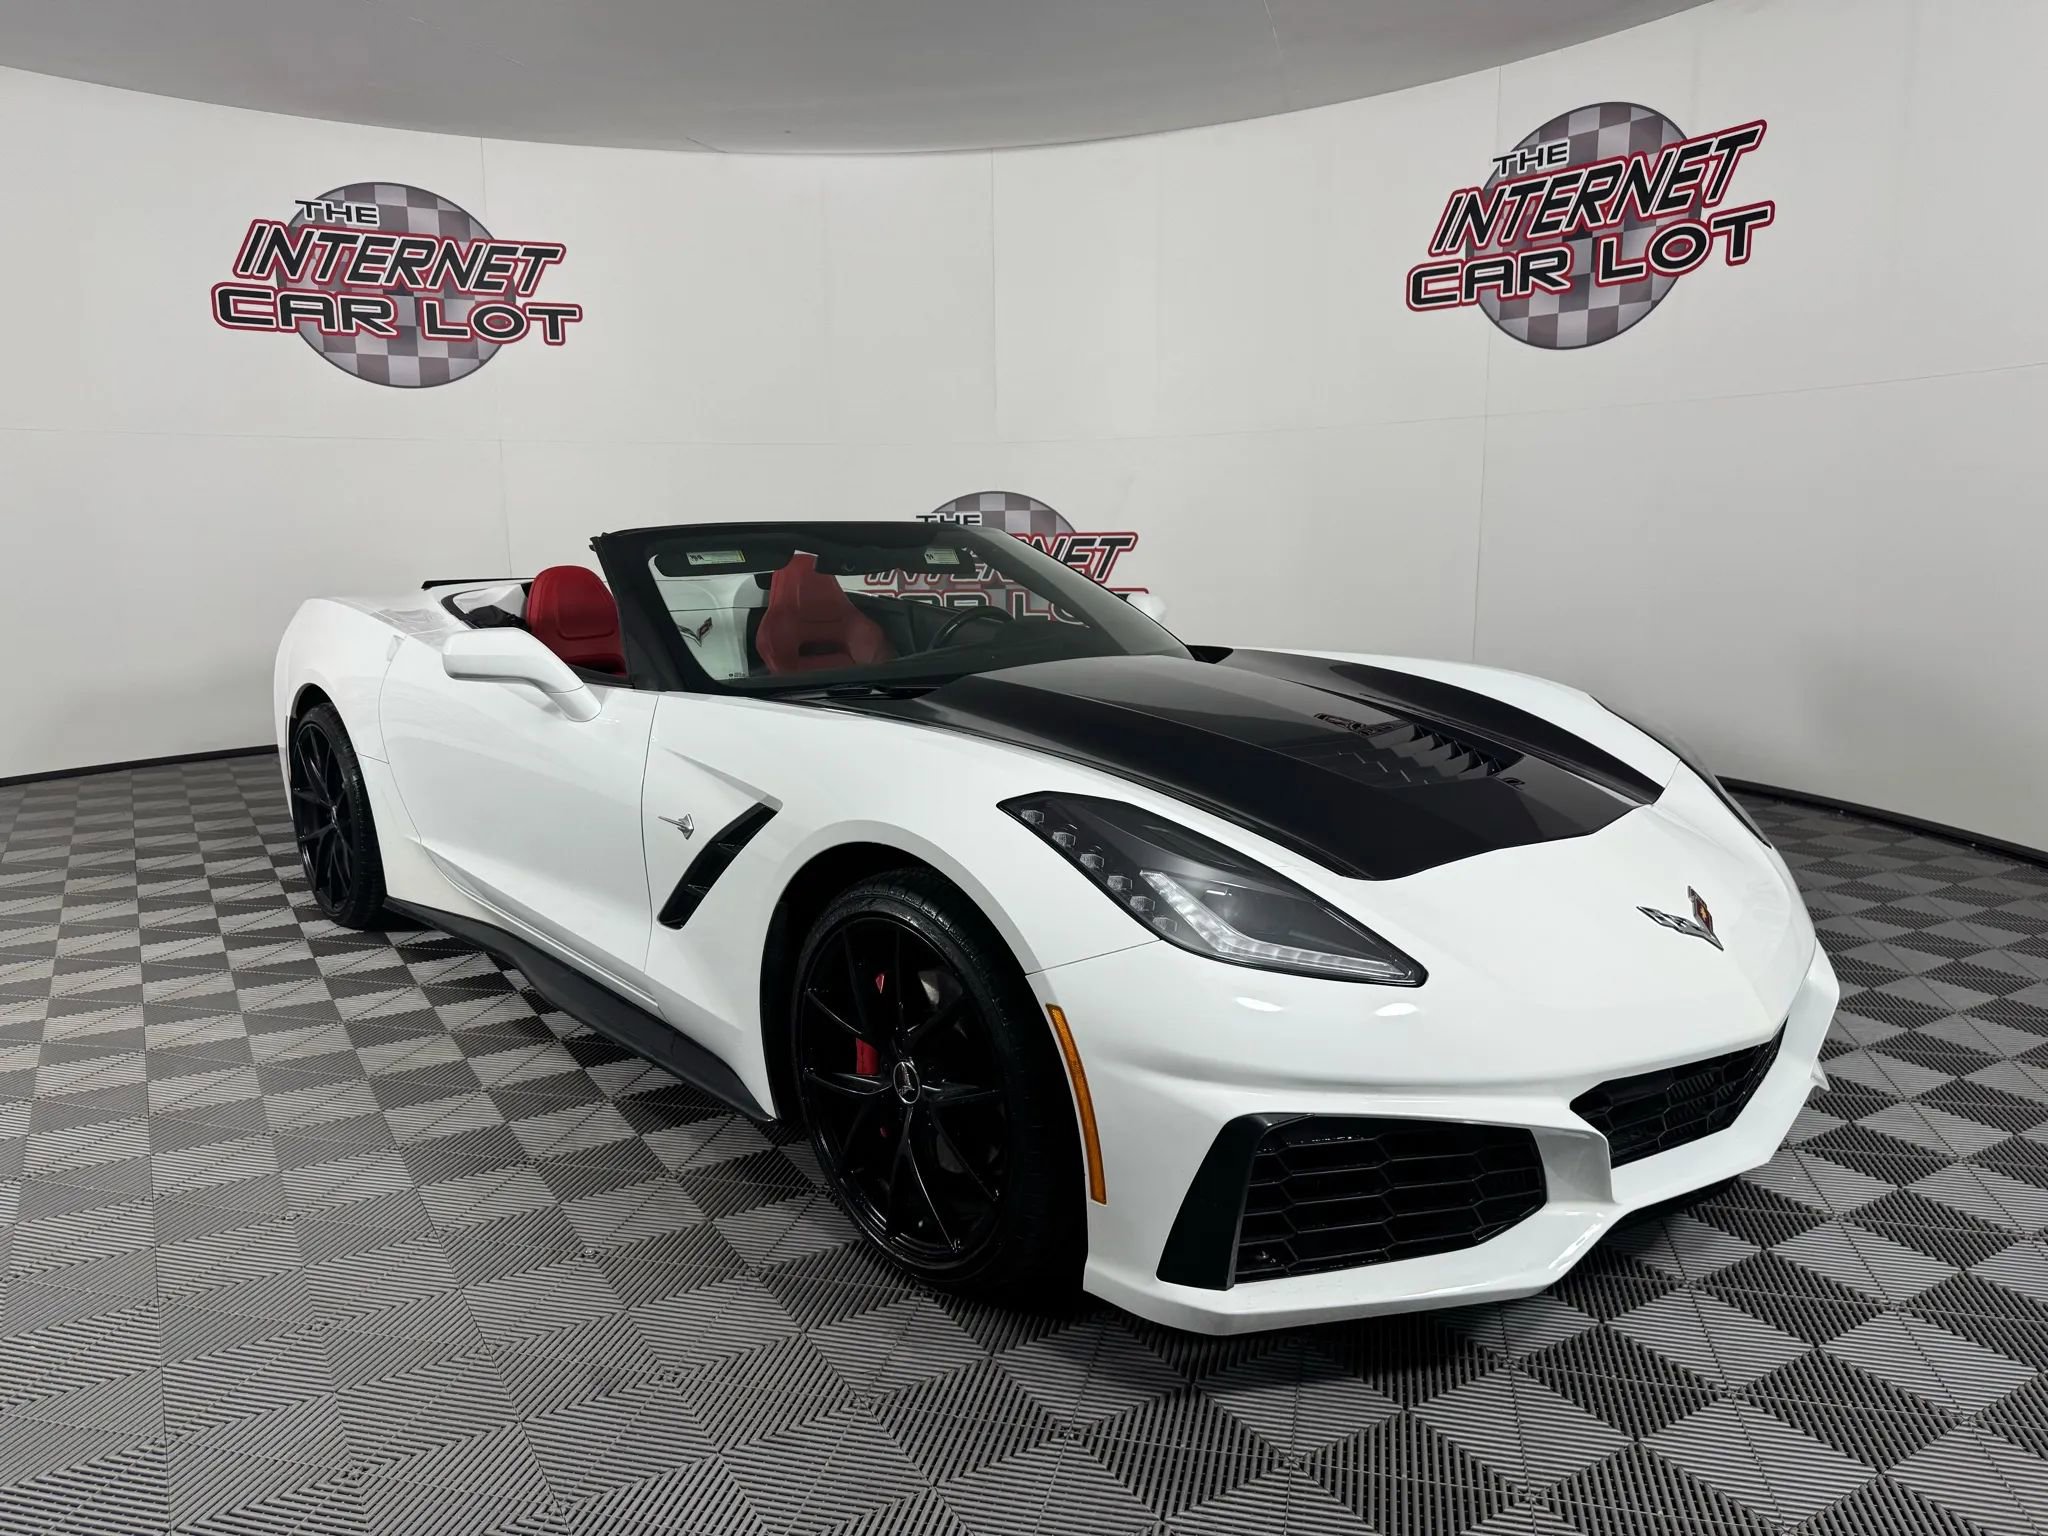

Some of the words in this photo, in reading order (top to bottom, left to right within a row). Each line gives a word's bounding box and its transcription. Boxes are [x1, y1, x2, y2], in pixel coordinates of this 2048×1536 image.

[1432, 124, 1765, 254] INTERNET
[1493, 140, 1569, 176] THE
[294, 199, 379, 225] THE
[236, 221, 565, 296] INTERNET
[1410, 246, 1571, 308] CAR
[1599, 205, 1771, 283] LOT
[215, 287, 398, 336] CAR
[421, 300, 581, 343] LOT
